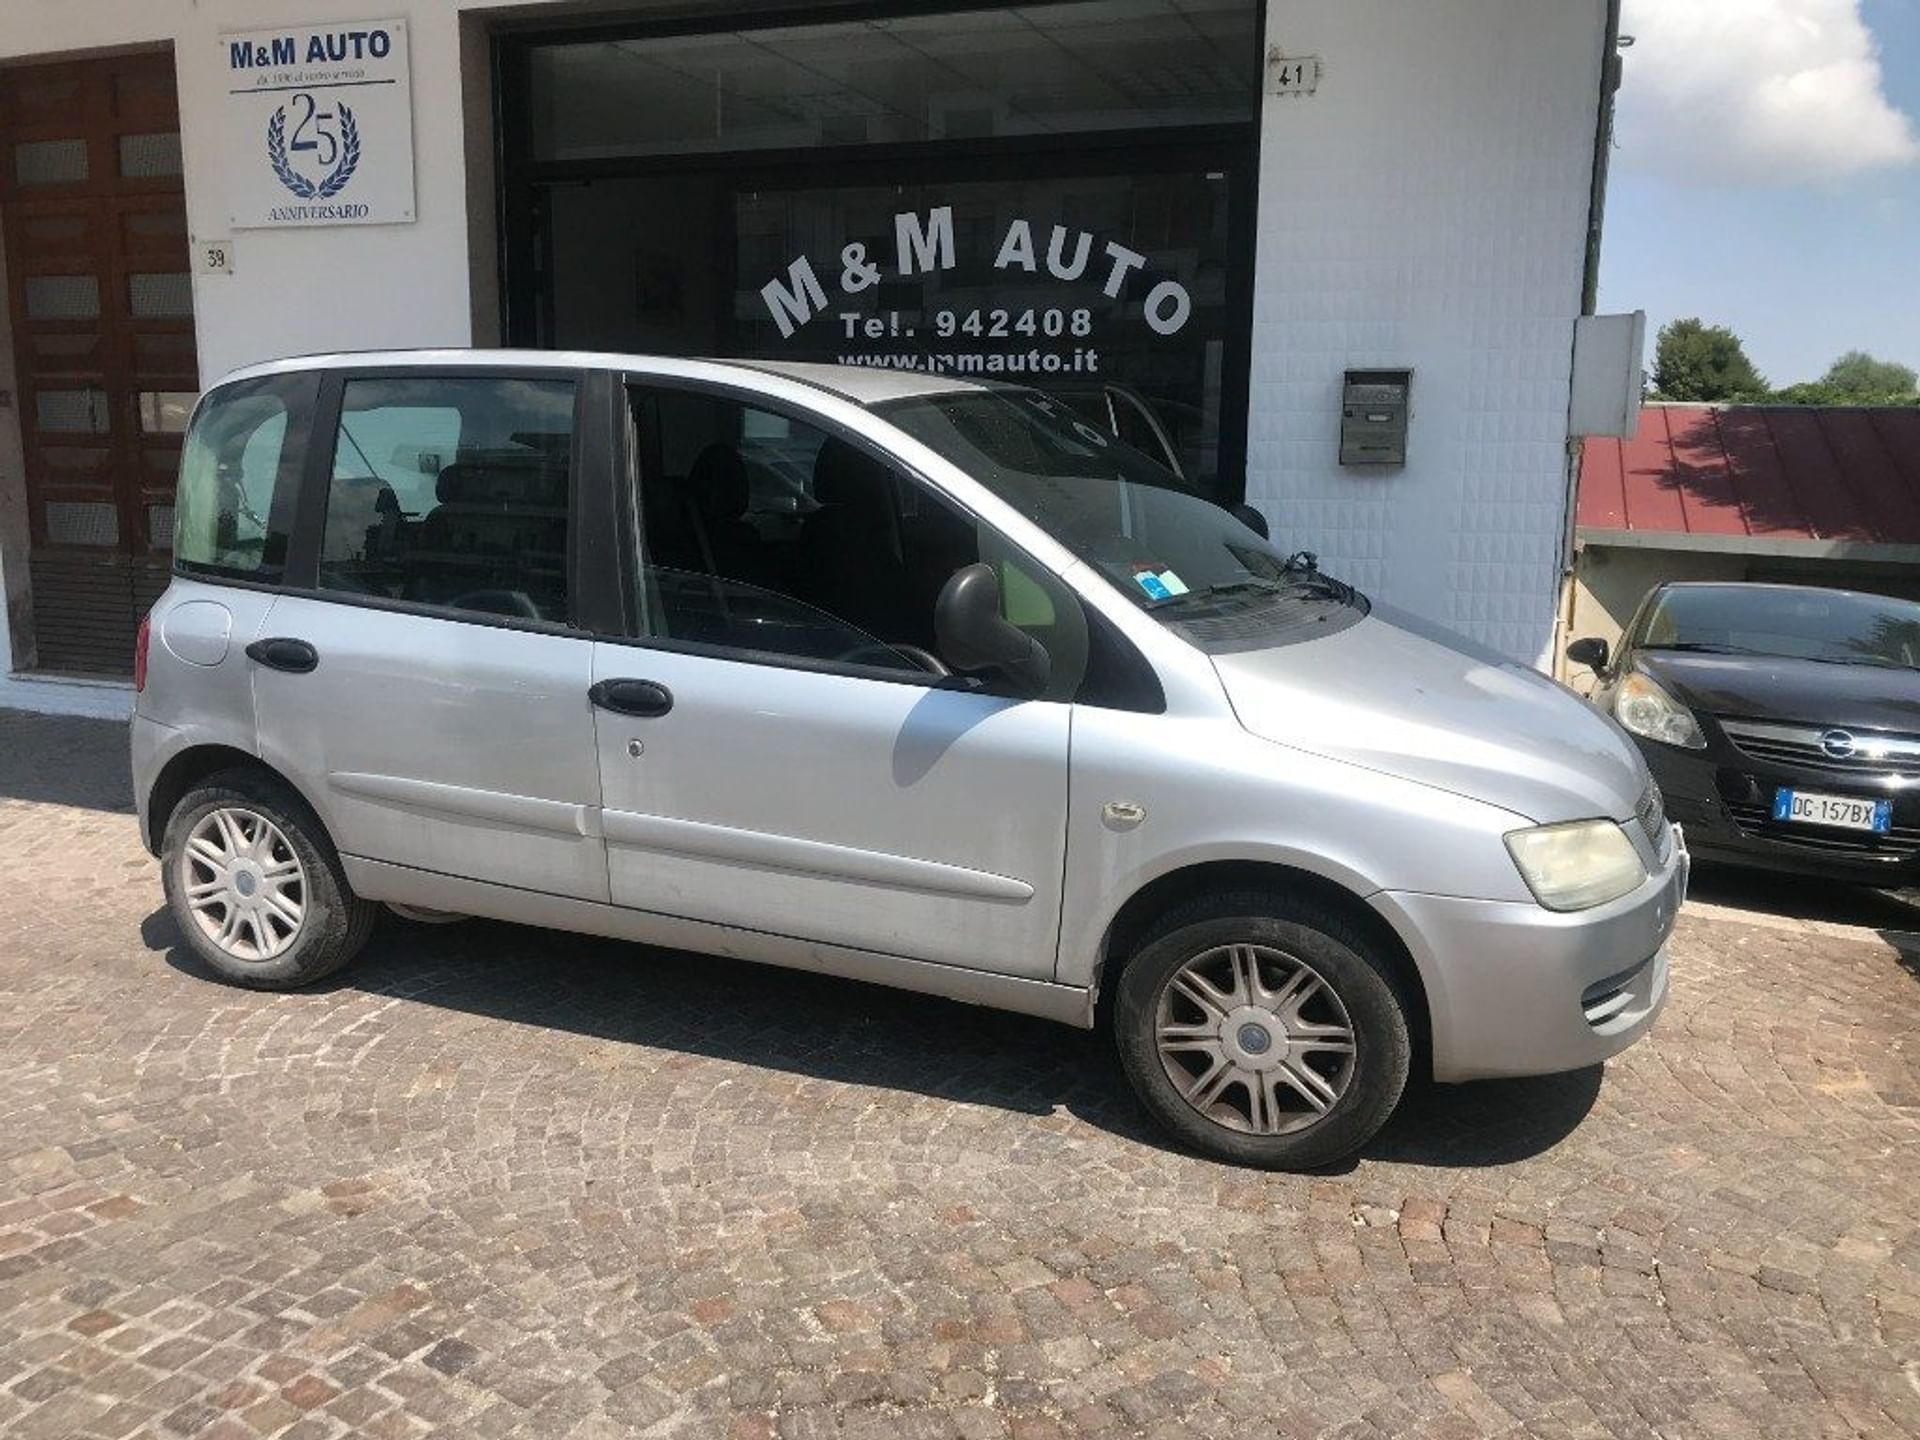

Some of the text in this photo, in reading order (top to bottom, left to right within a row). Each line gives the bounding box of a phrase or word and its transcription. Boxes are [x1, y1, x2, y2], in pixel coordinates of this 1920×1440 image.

[230, 30, 391, 69] M&M AUTO
[1279, 65, 1302, 86] 41
[291, 93, 337, 166] 25
[268, 204, 369, 221] ANNIVERSARIO
[207, 250, 225, 267] 39
[994, 219, 1192, 336] AUTO
[840, 309, 1092, 338] Tel. 942408
